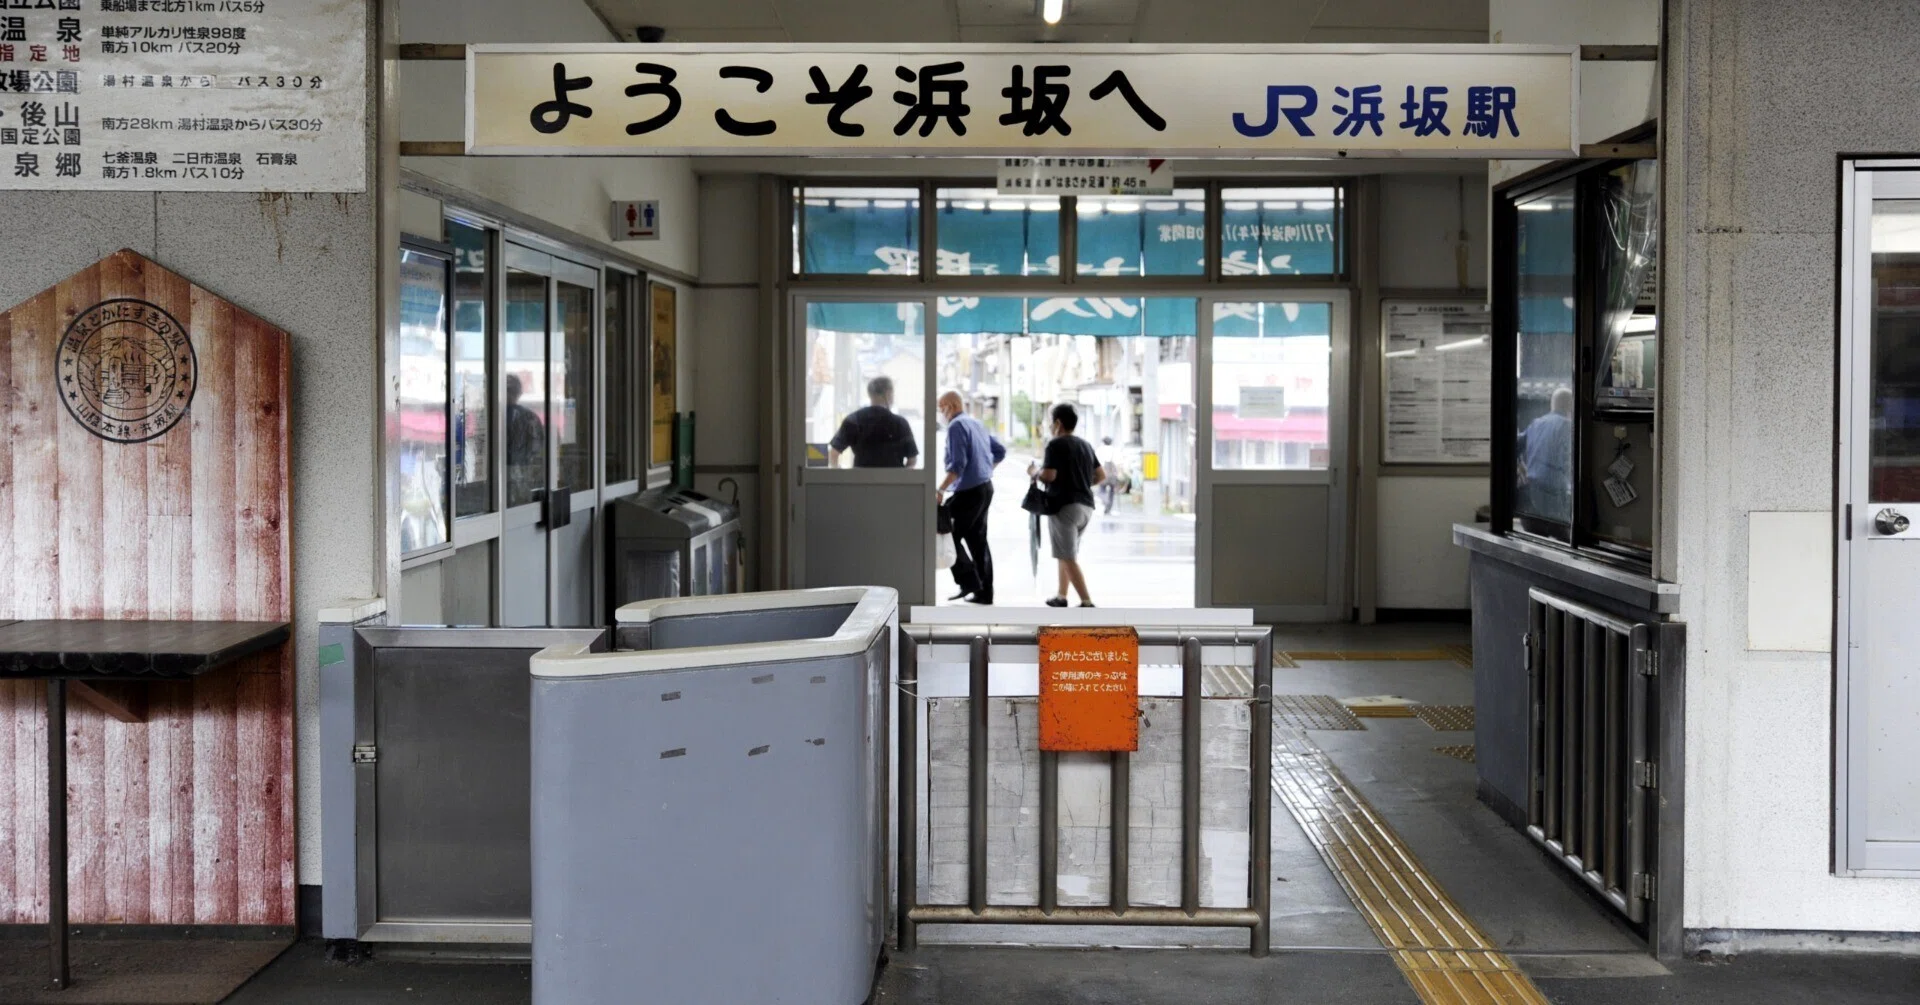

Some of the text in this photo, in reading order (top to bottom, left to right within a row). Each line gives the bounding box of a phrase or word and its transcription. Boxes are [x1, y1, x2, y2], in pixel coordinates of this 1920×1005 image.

[101, 26, 246, 40] 単純アルカリ性泉98度
[101, 41, 241, 54] 南方10km バス20分
[103, 75, 323, 89] 湯村温泉から バス30分
[529, 61, 1167, 138] ようこそ浜坂へ
[102, 117, 323, 131] 南方28km 湯村温泉からバス30分
[1, 128, 80, 146] 国定公園
[102, 151, 297, 166] 七釜温泉 二日市温泉 石膏泉
[102, 166, 244, 180] 南方1.8km バス10分
